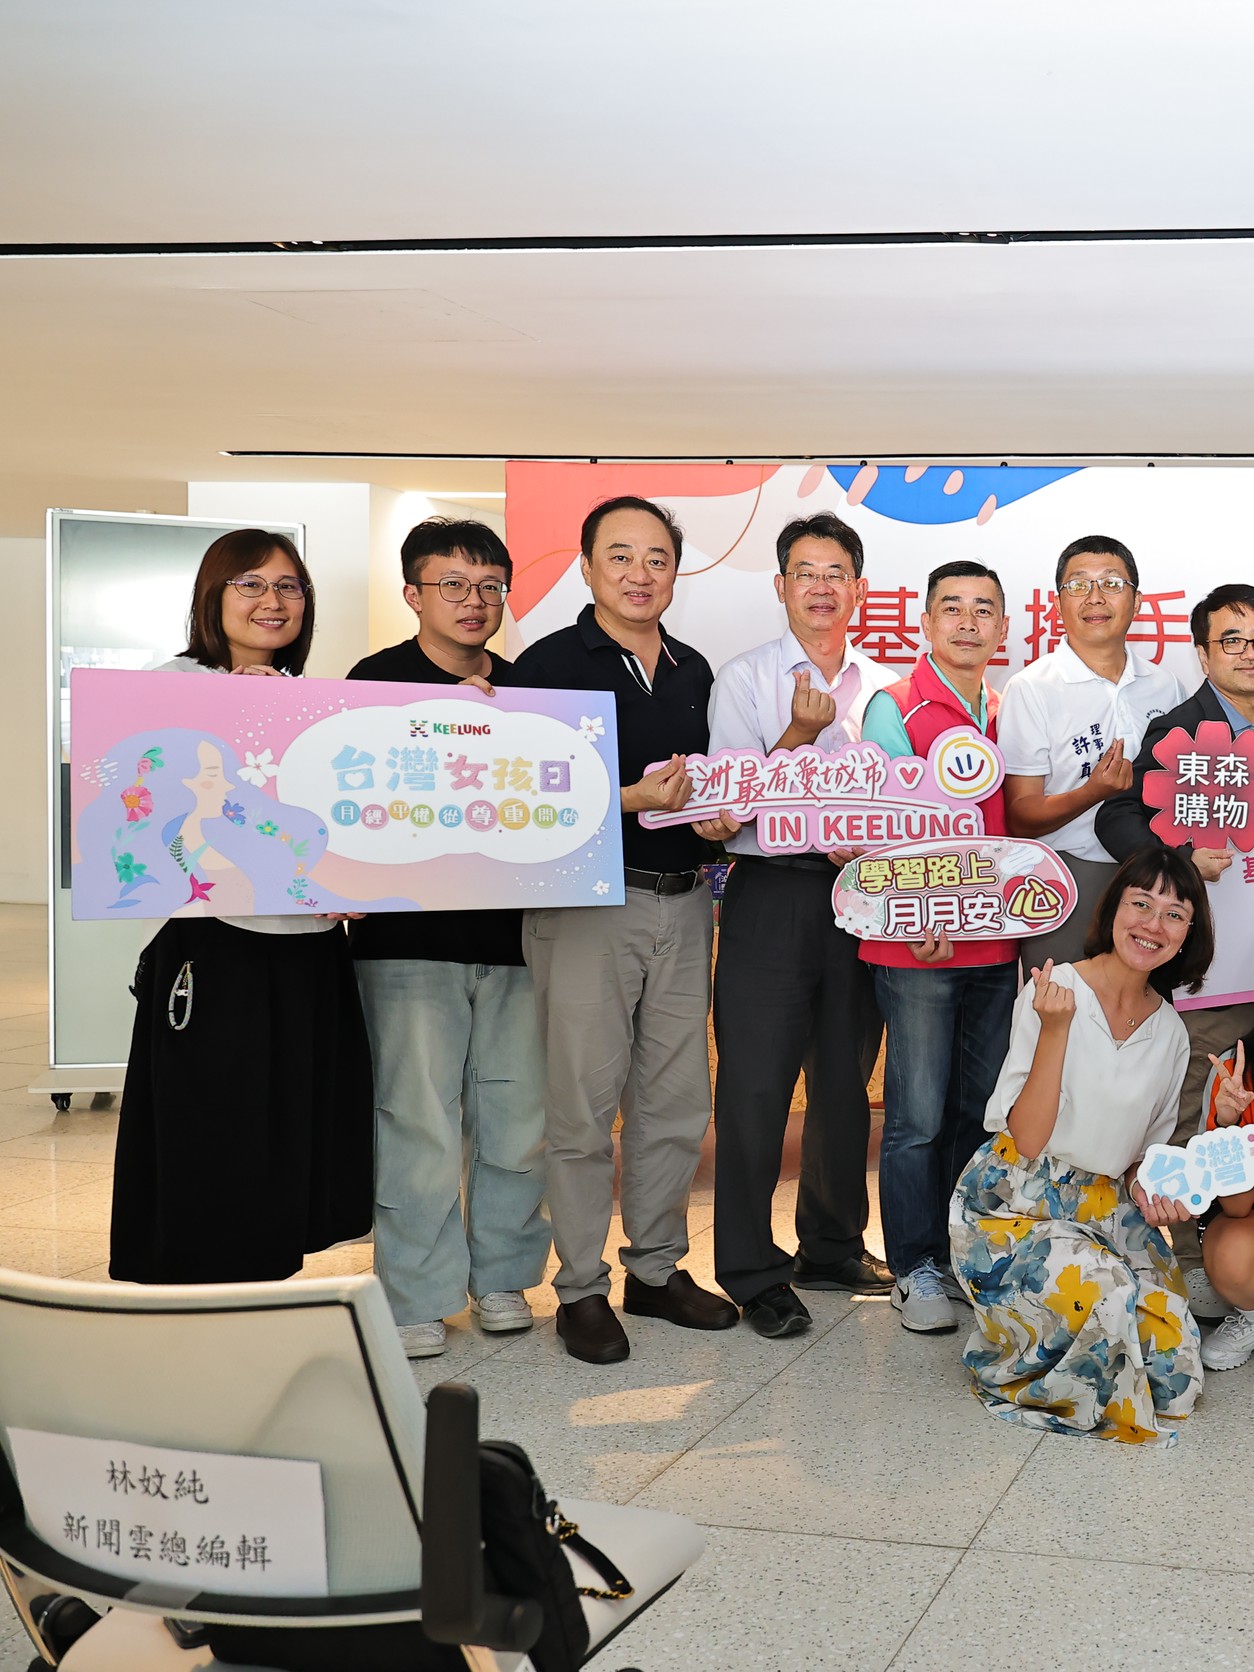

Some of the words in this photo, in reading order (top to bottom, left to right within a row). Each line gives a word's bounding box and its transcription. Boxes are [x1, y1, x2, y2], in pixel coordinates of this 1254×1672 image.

[433, 722, 491, 736] KEELUNG
[331, 744, 571, 793] 台灣女孩日
[685, 753, 884, 810] 洲最有愛城市
[1175, 751, 1250, 788] 東森
[338, 801, 580, 829] 月經平權從尊重開始
[768, 815, 801, 843] IN
[823, 812, 975, 842] KEELUNG
[1173, 793, 1249, 829] 購物
[858, 852, 997, 893] 學習路上
[884, 878, 1064, 935] 月月安心
[106, 1460, 210, 1505] 林妏純
[62, 1510, 273, 1571] 新聞雲總編輯
